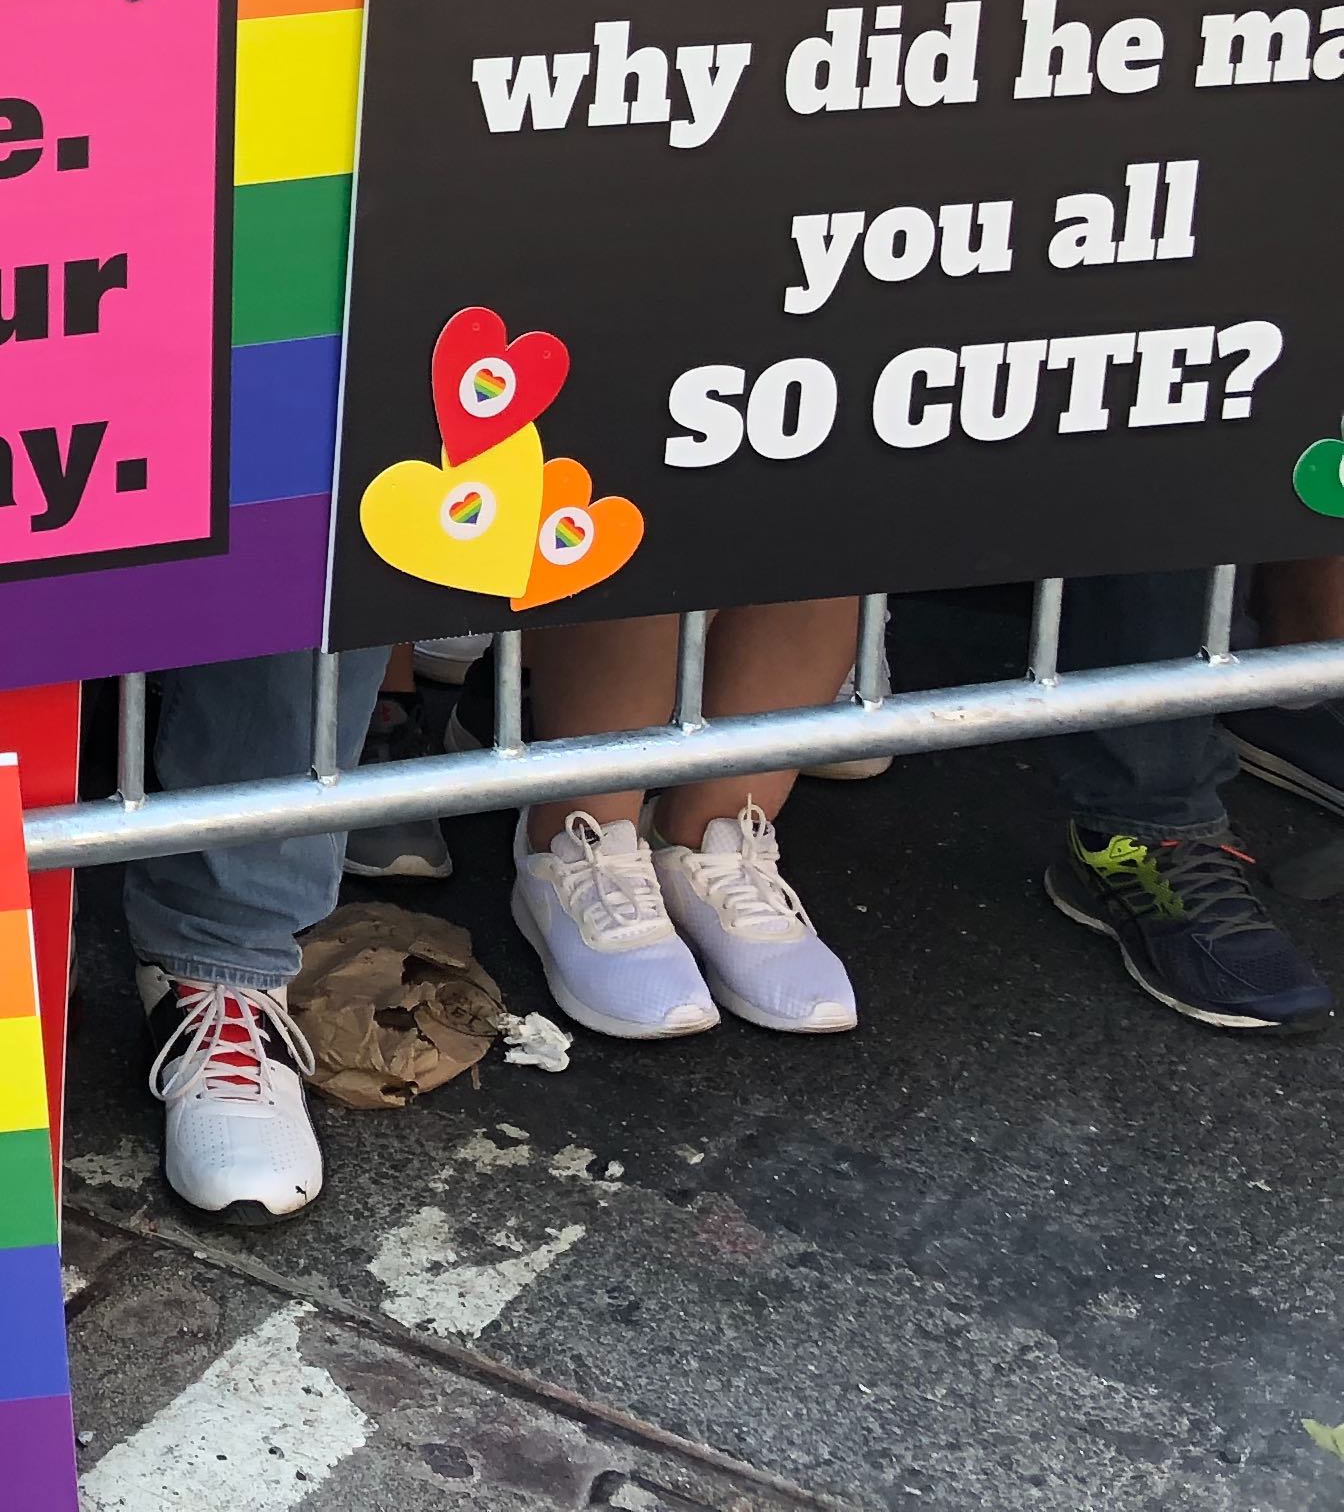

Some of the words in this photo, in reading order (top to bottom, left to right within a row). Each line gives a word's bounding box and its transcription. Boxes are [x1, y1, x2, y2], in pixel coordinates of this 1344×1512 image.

[471, 20, 752, 149] why
[785, 0, 982, 115] did
[783, 193, 1014, 315] you
[1048, 159, 1200, 269] all
[664, 357, 838, 468] SO
[872, 320, 1283, 449] CUTE?
